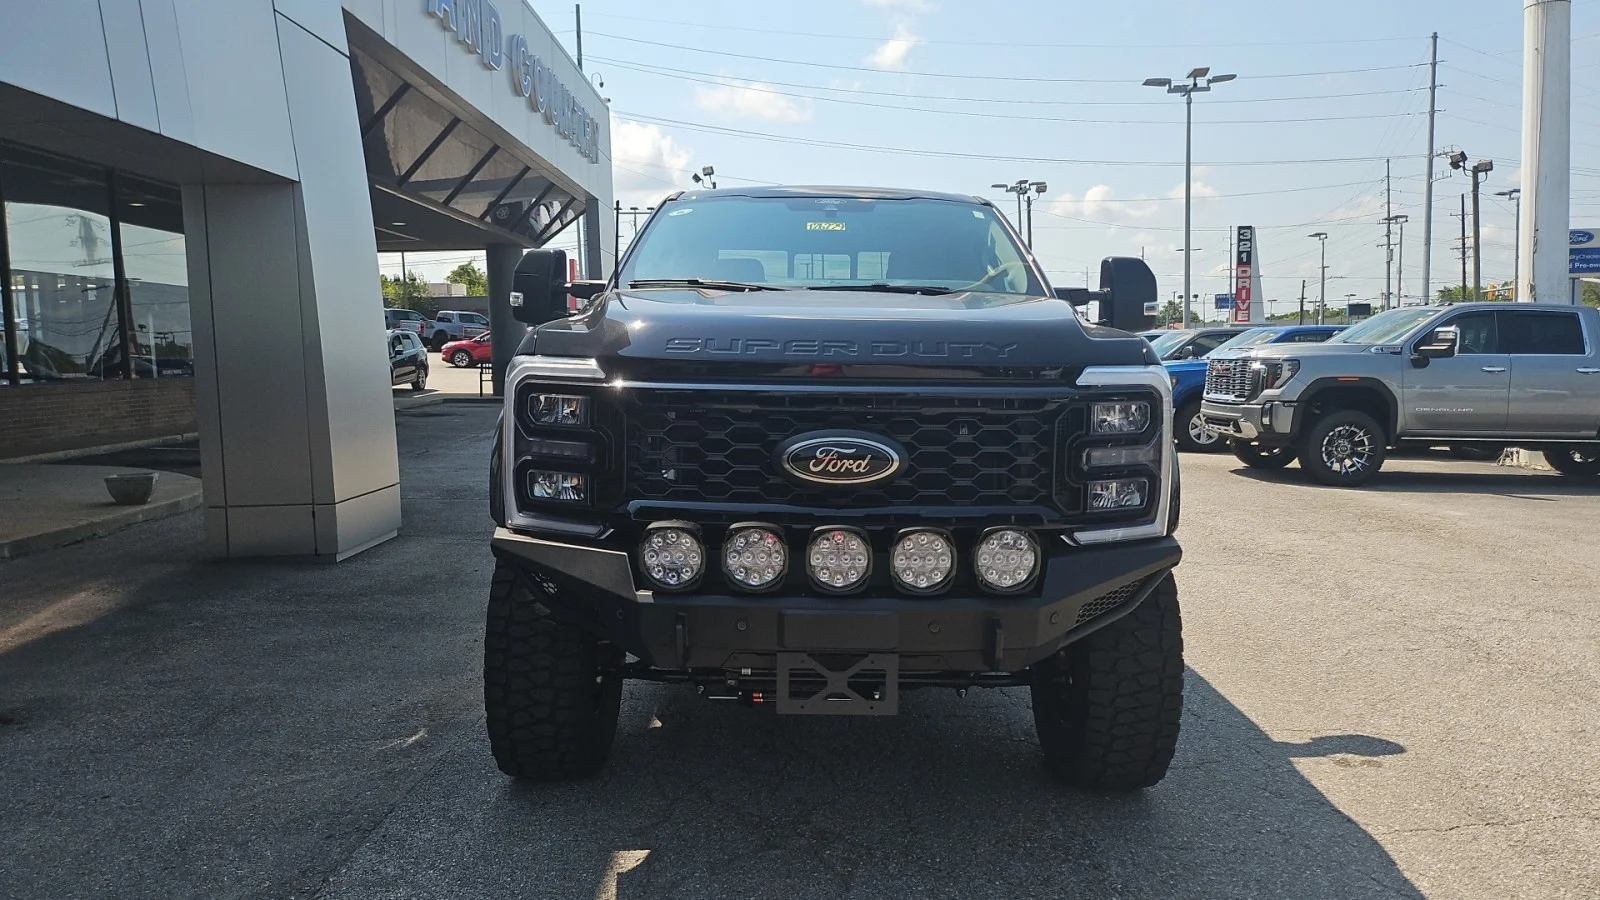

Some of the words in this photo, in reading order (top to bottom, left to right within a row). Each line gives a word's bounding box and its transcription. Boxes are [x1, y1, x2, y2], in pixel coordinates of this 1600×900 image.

[512, 34, 599, 164] COUNTRY
[1239, 229, 1252, 262] 321
[1236, 267, 1251, 320] DRIVE
[665, 338, 858, 356] SUPER
[871, 342, 1017, 358] DUTY
[809, 446, 872, 473] Ford
